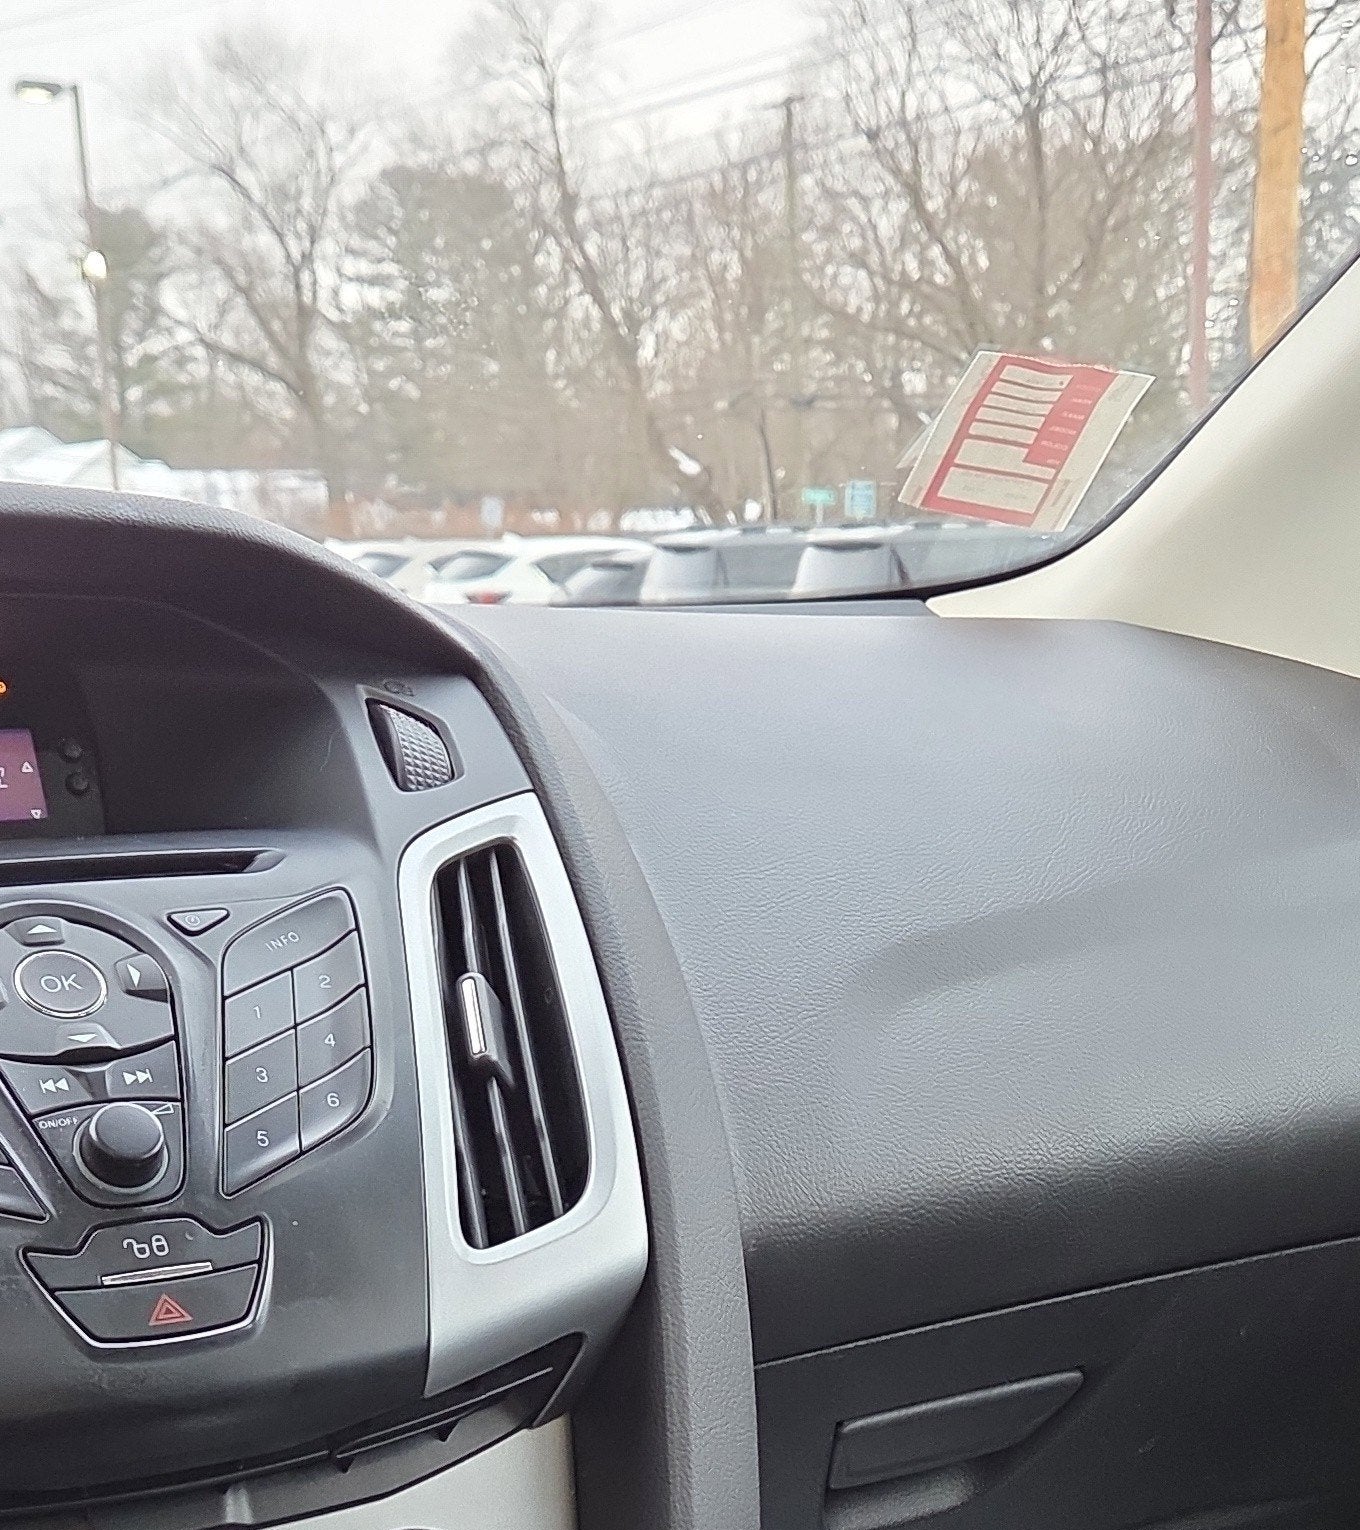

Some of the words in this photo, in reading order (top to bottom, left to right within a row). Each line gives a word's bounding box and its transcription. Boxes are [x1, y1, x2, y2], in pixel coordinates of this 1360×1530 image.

[265, 931, 300, 952] INFO
[39, 972, 82, 994] OK
[318, 974, 332, 989] 2
[252, 1005, 262, 1019] 1
[324, 1033, 336, 1047] 4
[255, 1067, 269, 1083] 3
[326, 1092, 341, 1108] 6
[38, 1116, 78, 1130] ON/OFF
[256, 1130, 270, 1147] 5
